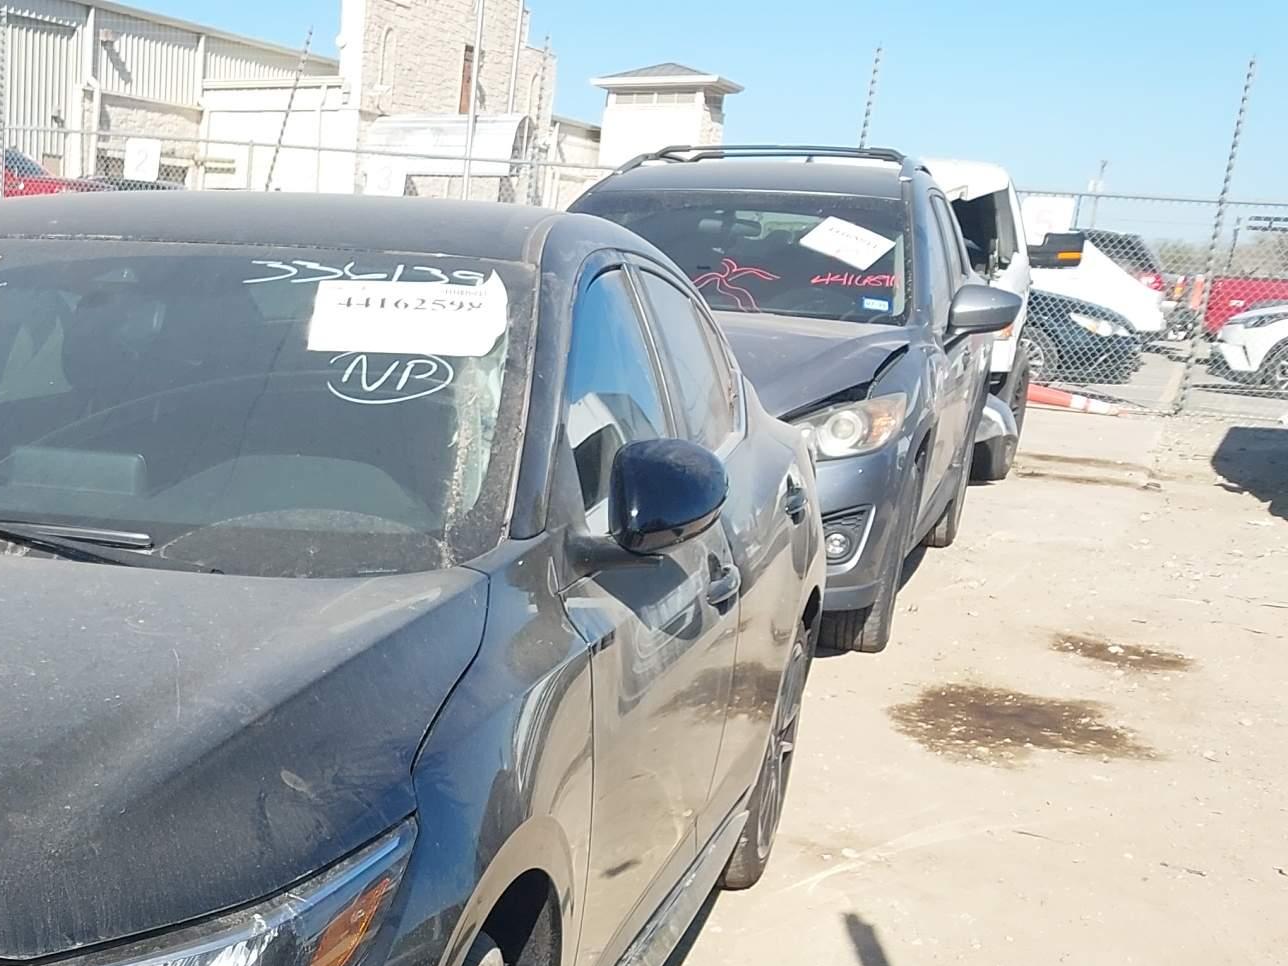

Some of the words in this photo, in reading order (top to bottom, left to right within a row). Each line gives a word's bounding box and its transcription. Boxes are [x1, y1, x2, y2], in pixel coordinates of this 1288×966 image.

[135, 148, 149, 173] 2
[376, 166, 393, 191] 3
[342, 354, 438, 392] NP
